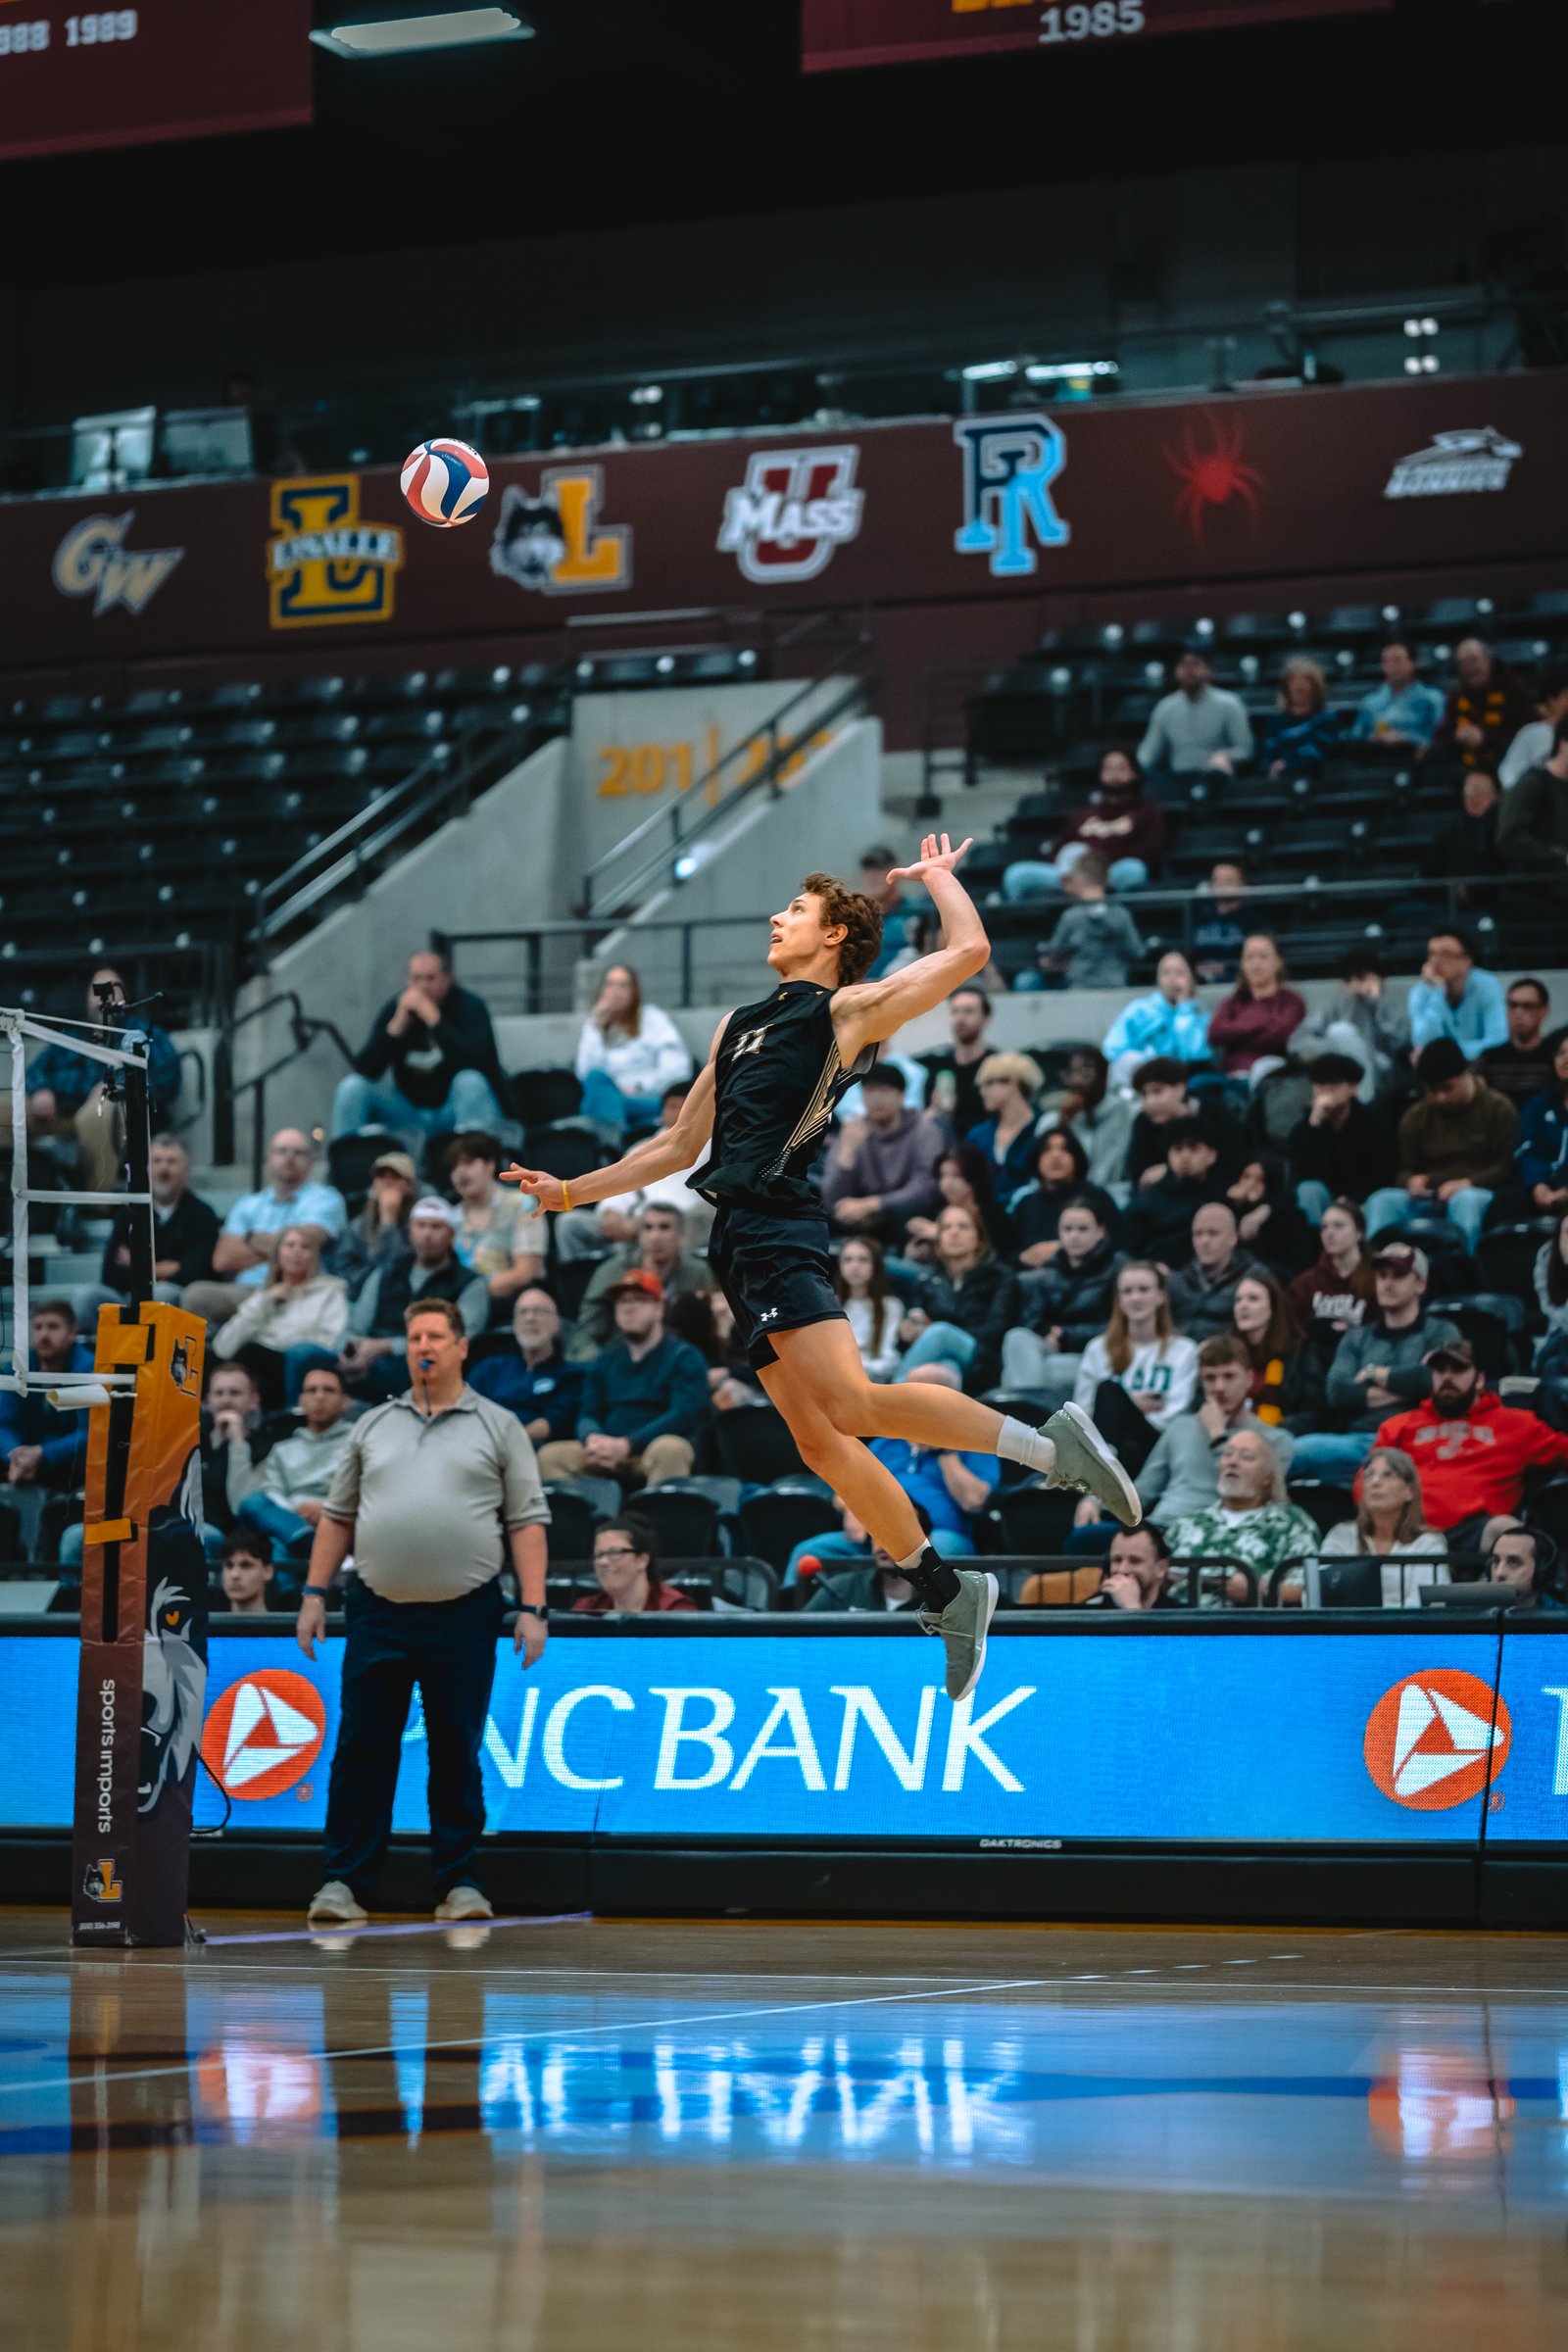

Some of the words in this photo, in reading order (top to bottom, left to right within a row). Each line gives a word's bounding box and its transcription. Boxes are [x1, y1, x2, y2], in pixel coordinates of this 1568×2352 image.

[0, 20, 50, 56] 988
[65, 9, 138, 47] 1989
[1038, 0, 1146, 44] 1985
[52, 509, 186, 618] GW
[99, 1679, 116, 1746] sports
[403, 1683, 635, 1790] NC
[649, 1686, 1037, 1791] BANK
[97, 1750, 114, 1834] imports
[979, 1838, 1062, 1849] DAKTRONICS
[97, 1858, 122, 1902] L
